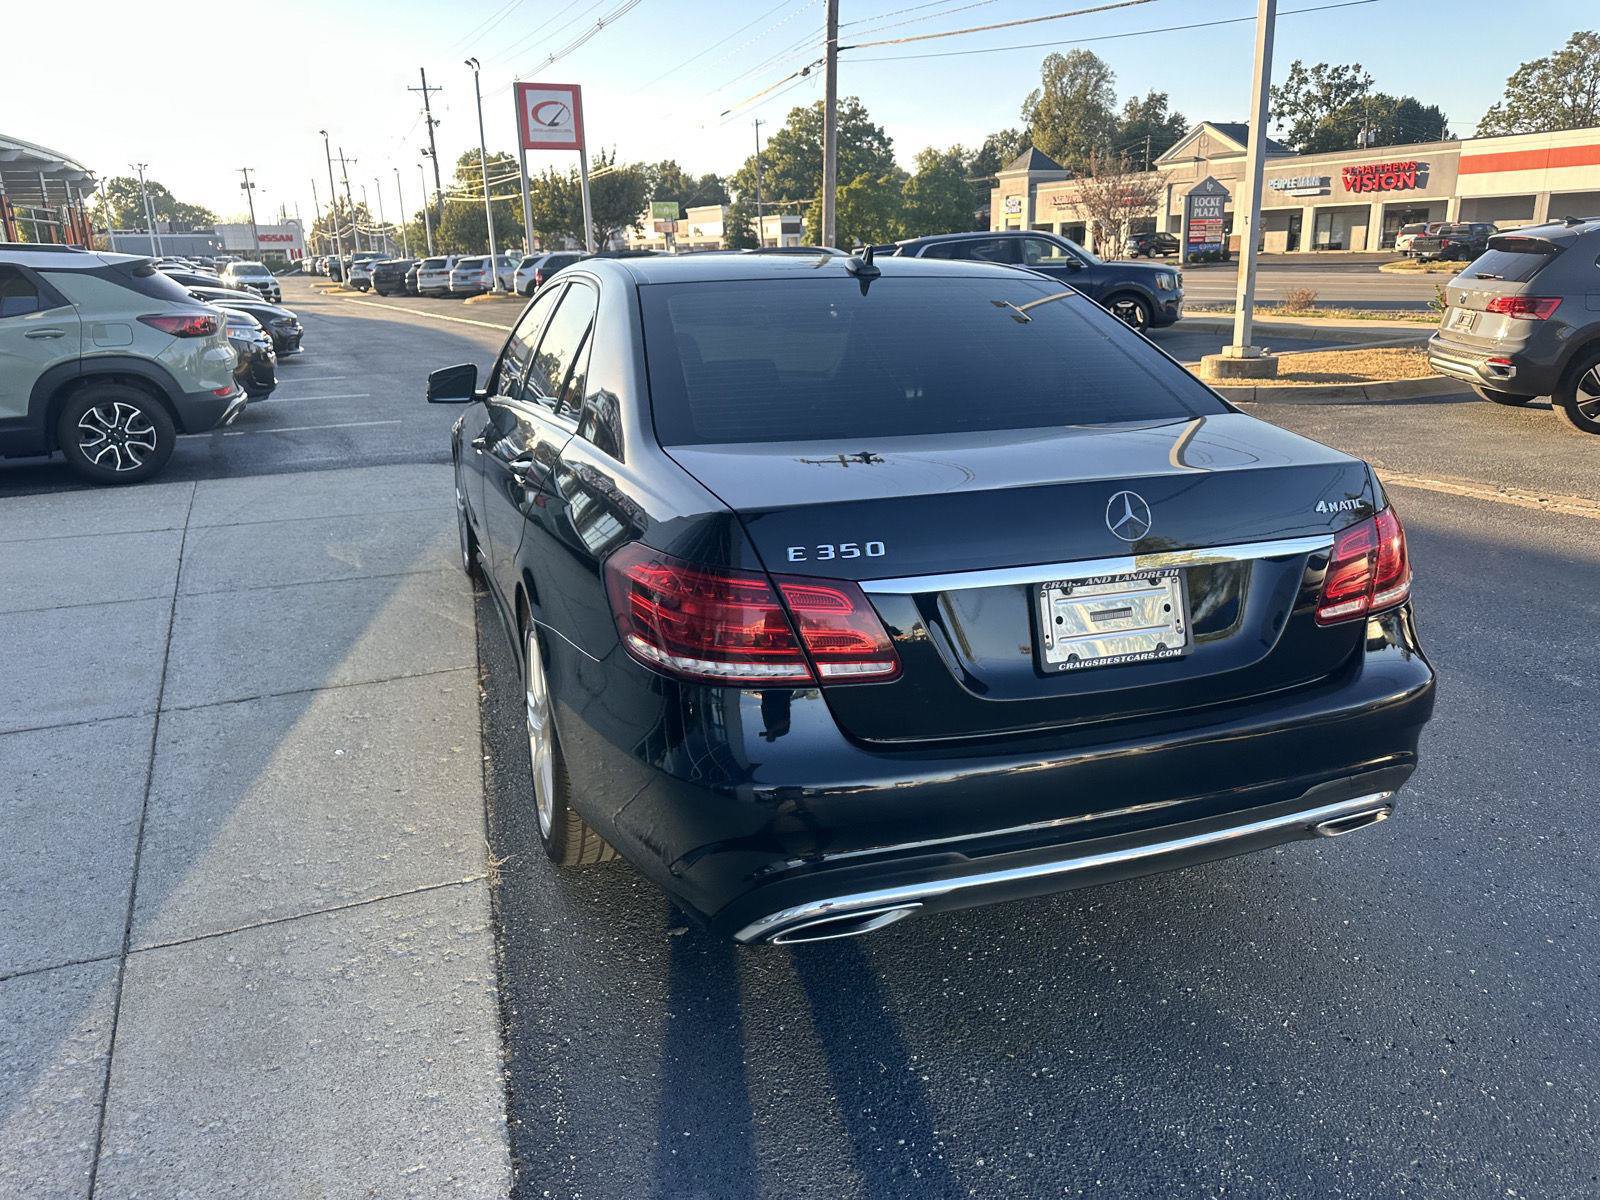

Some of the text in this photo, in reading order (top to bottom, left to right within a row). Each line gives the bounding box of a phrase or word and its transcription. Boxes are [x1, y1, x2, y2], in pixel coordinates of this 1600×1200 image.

[1357, 160, 1417, 175] MATTHEWS
[1341, 172, 1417, 193] VISION
[1194, 197, 1221, 207] LOCKE
[1193, 207, 1220, 217] PLAZA
[787, 541, 886, 562] E 350
[1084, 575, 1113, 586] AND
[1115, 568, 1180, 582] LANDRETH
[1058, 648, 1183, 671] CRAIGSBESTCARS.COM
